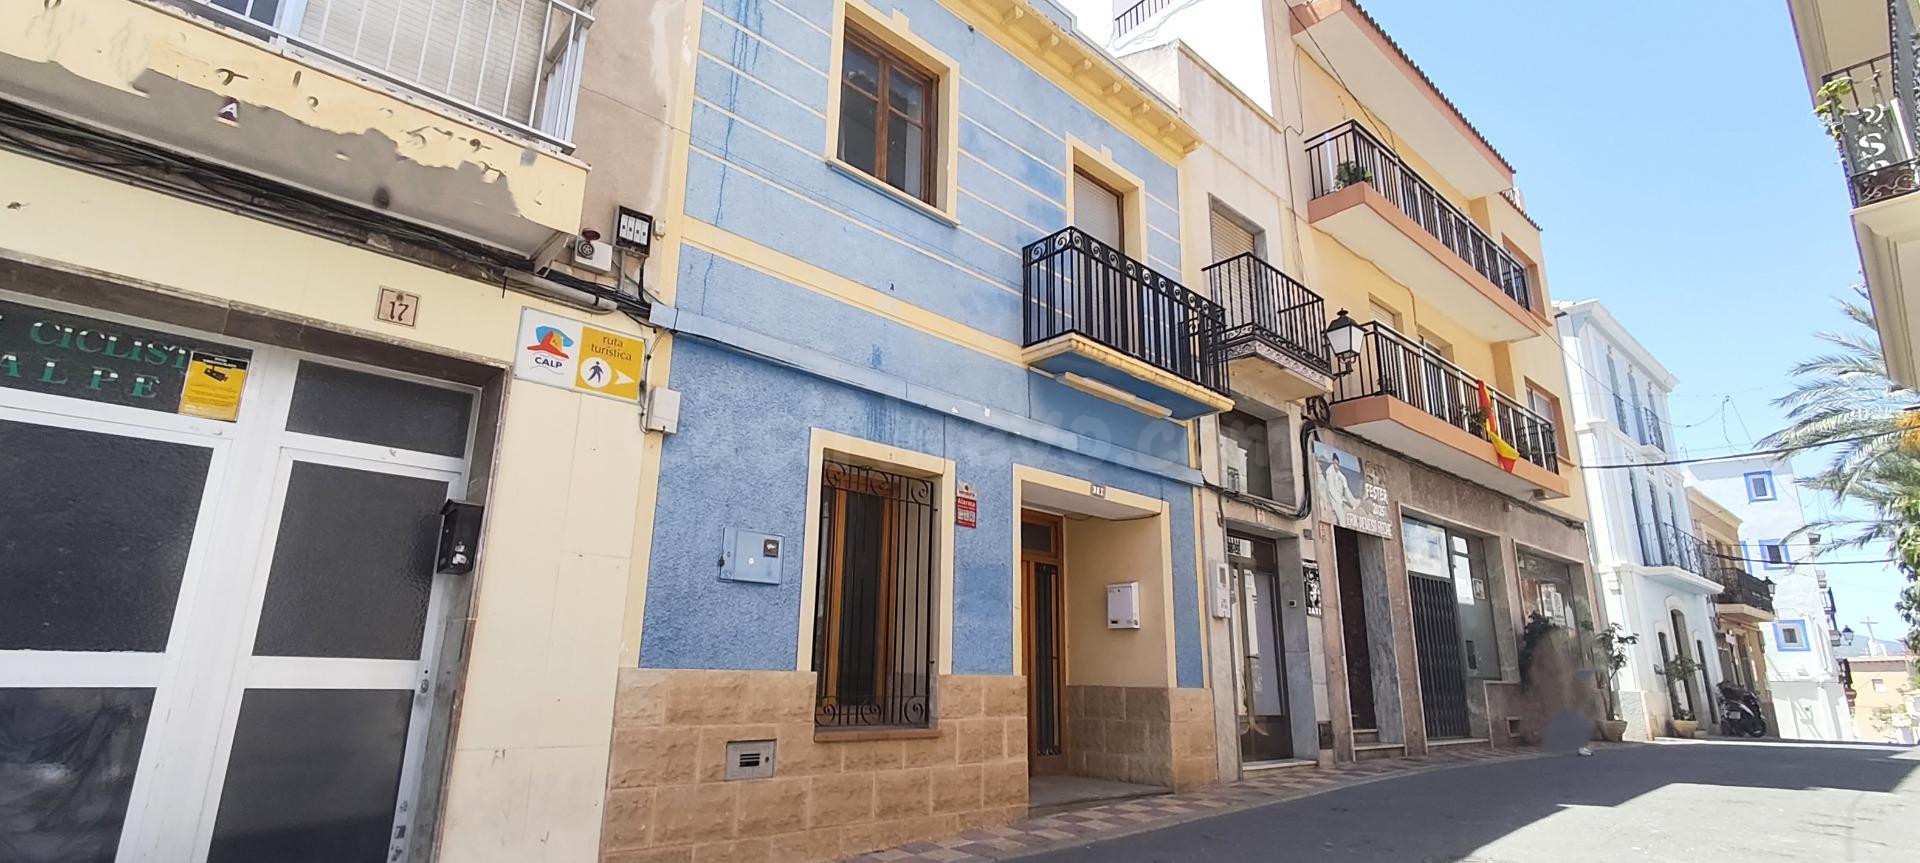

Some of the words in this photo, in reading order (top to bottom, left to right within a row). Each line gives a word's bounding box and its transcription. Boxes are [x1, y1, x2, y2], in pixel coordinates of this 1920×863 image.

[389, 300, 410, 322] 17
[602, 334, 624, 348] ruta
[590, 344, 633, 361] turística
[534, 356, 563, 370] CALP
